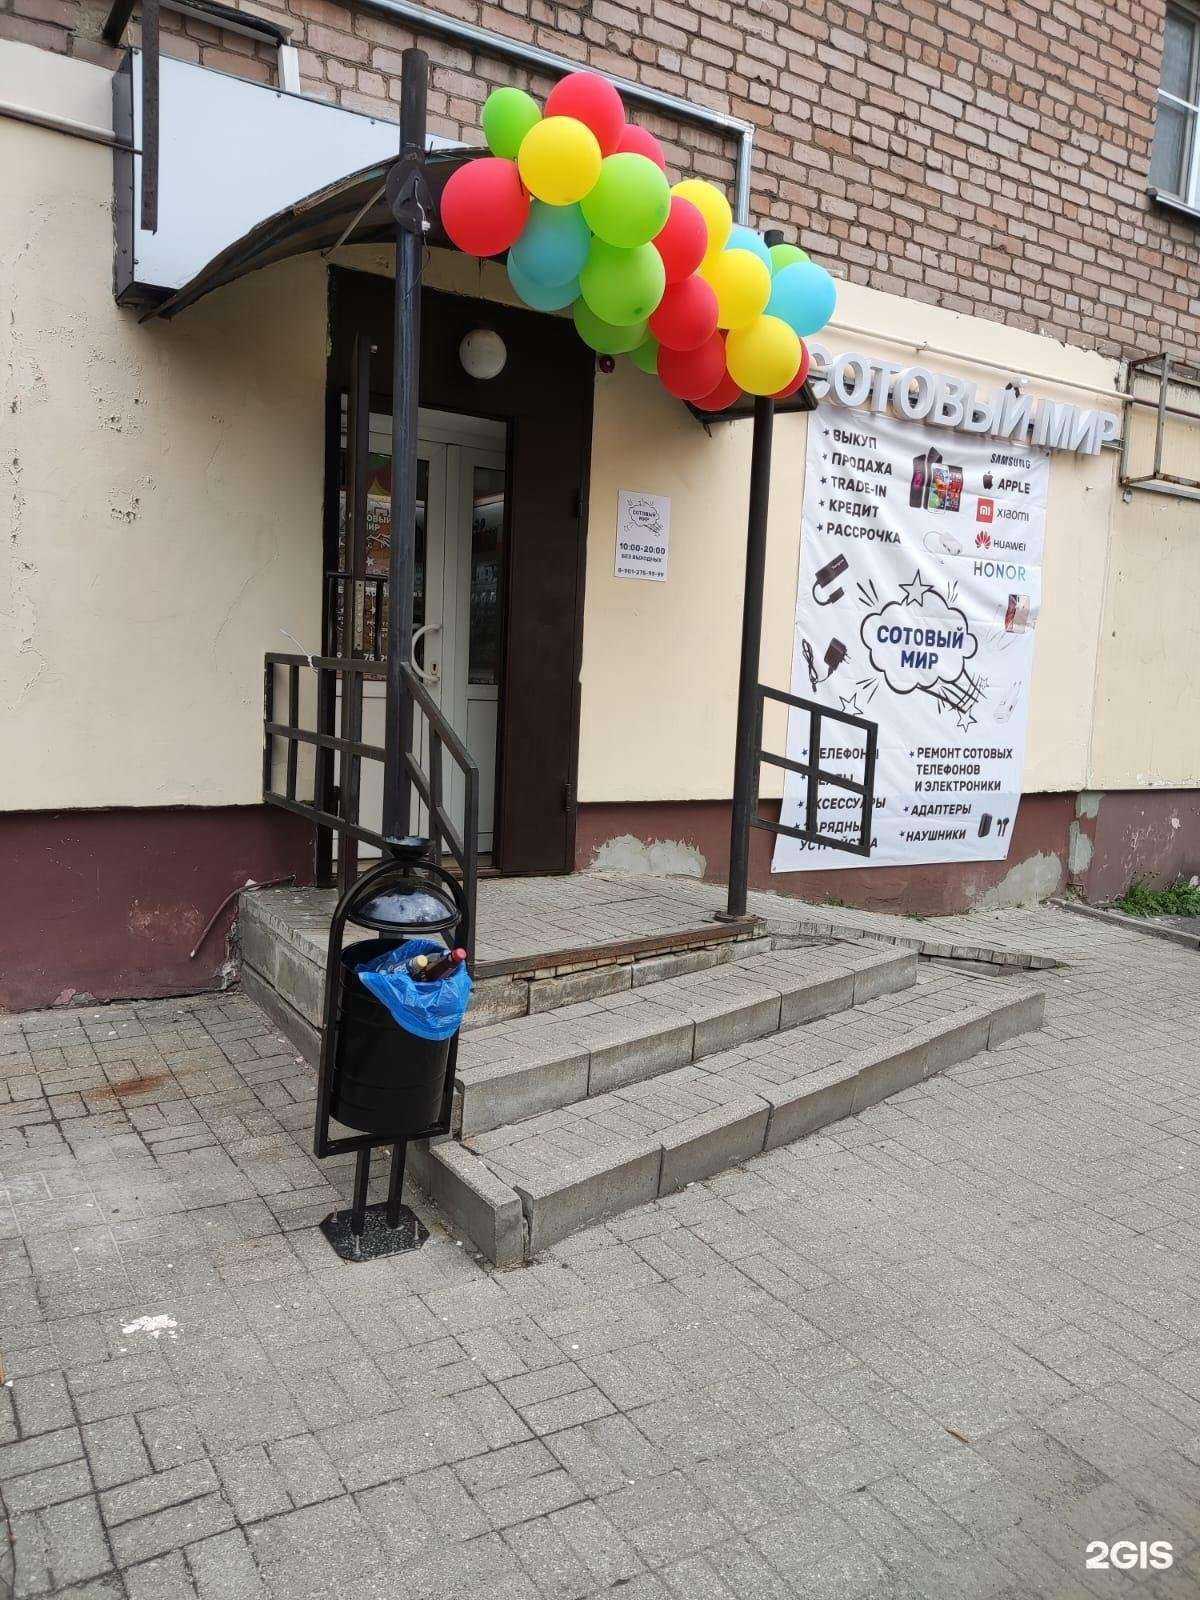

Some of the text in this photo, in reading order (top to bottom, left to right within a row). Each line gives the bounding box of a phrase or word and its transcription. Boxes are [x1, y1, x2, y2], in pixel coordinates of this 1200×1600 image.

[807, 343, 1122, 456] СОТОВЫЙ МИР
[833, 429, 877, 449] ВЫКУП
[832, 452, 893, 475] ПРОДАЖА
[990, 453, 1031, 469] SAMSUNG
[831, 476, 887, 498] TRADE-IN
[997, 478, 1030, 494] APPLE
[829, 499, 879, 518] КРЕДИТ
[826, 522, 902, 544] РАССРОЧКА
[993, 540, 1026, 552] HUAWEI
[973, 561, 1026, 581] HONOR
[877, 625, 964, 649] СОТОВЫЙ
[901, 650, 939, 670] МИР
[917, 747, 1013, 759] РЕМОНТ СОТОВЫХ
[917, 764, 981, 775] ТЕЛЕФОНОВ
[915, 780, 1002, 792] И ЭЛЕКТРОНИКИ
[911, 804, 972, 817] АДАПТЕРЫ
[906, 829, 966, 842] НАУШНИКИ
